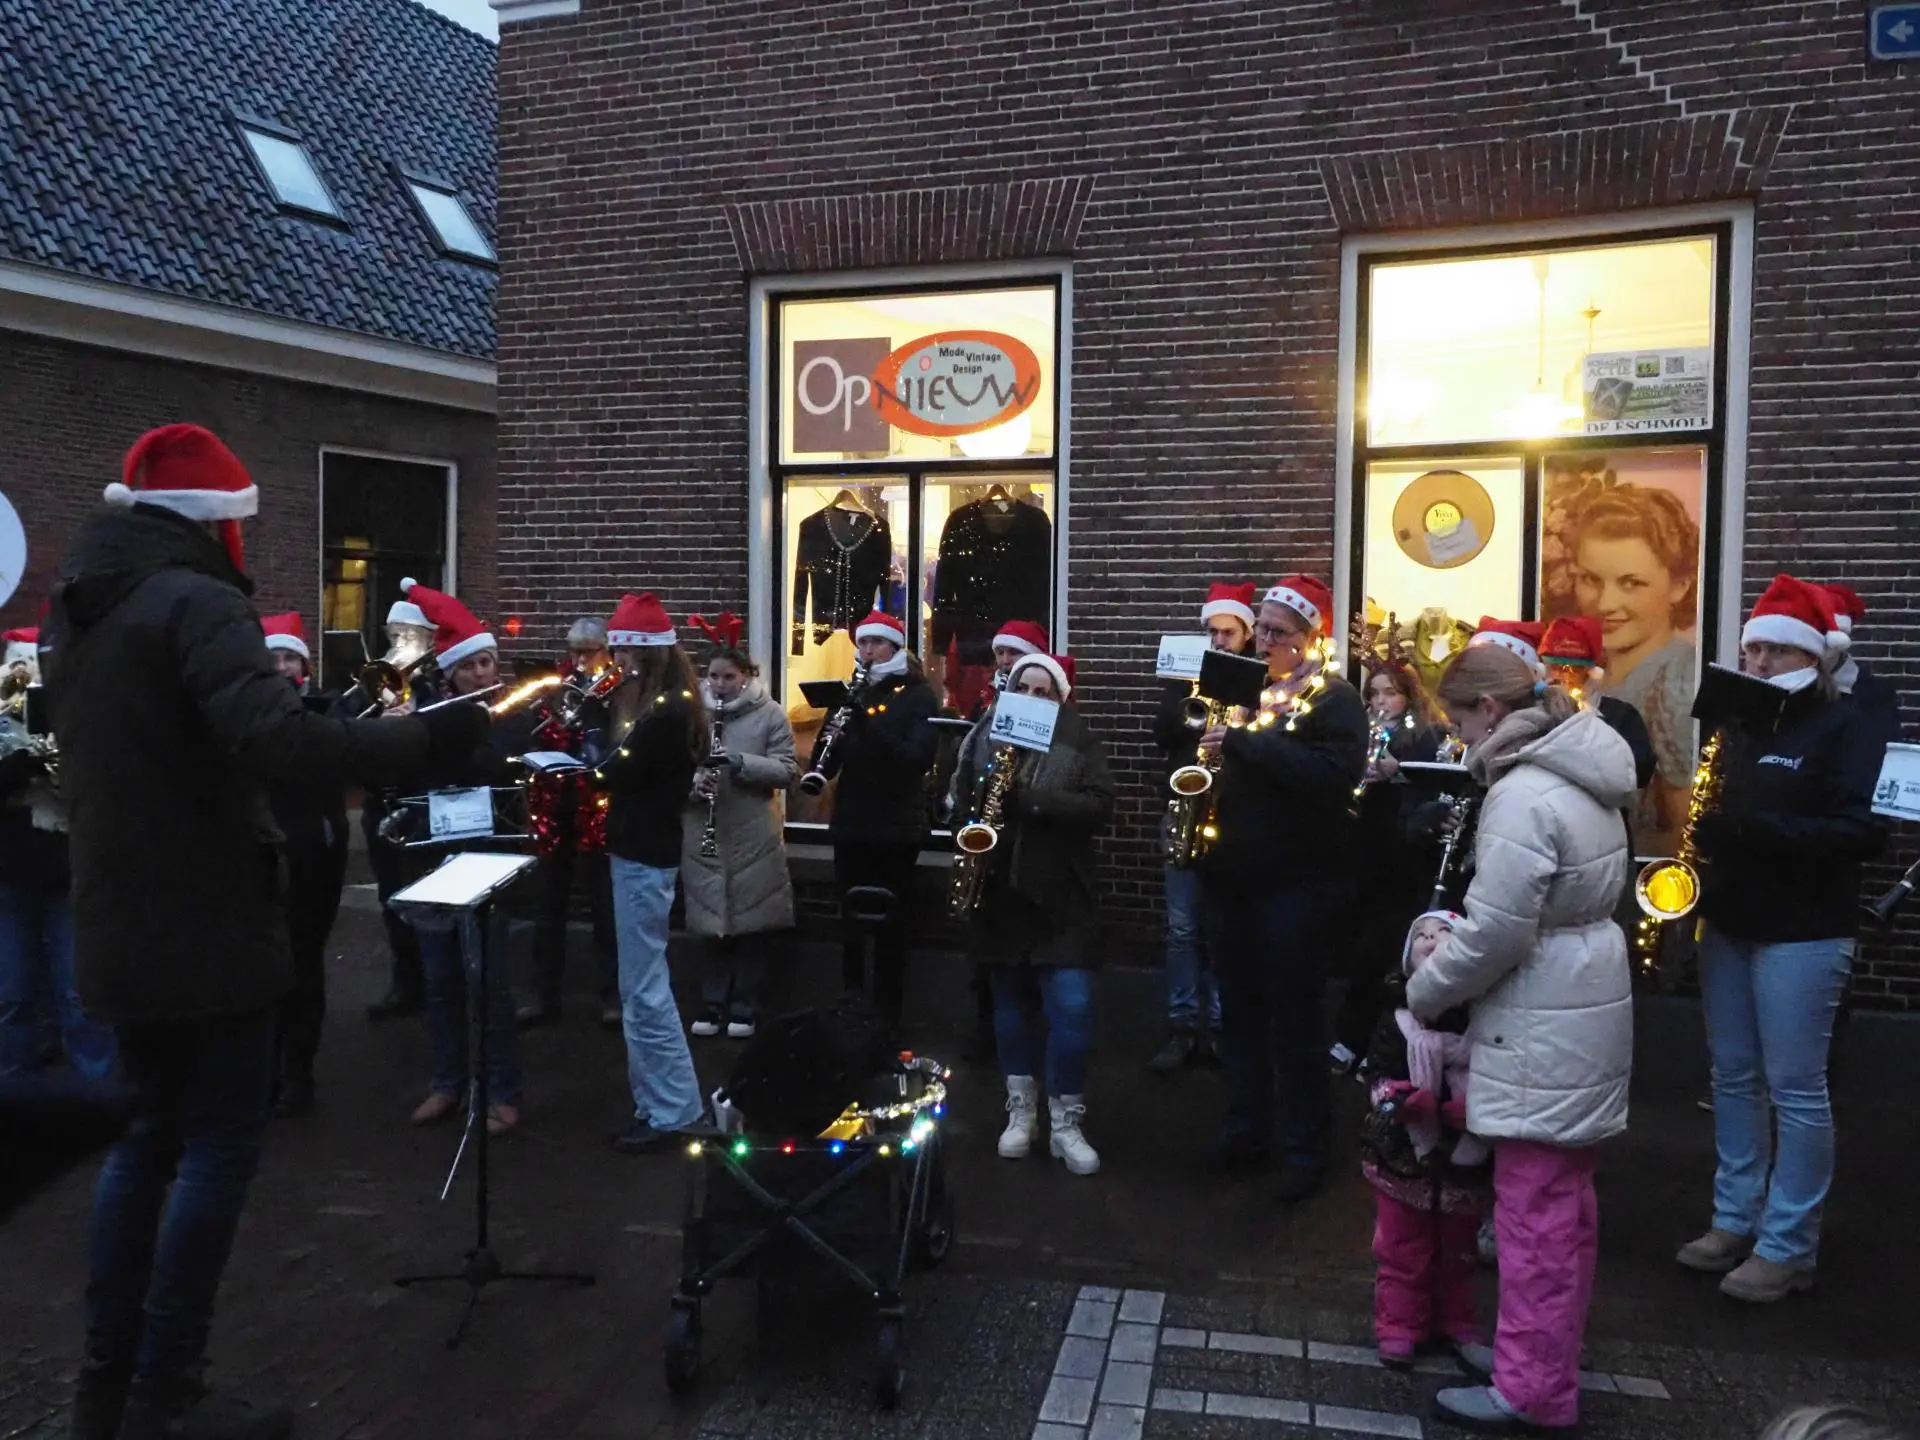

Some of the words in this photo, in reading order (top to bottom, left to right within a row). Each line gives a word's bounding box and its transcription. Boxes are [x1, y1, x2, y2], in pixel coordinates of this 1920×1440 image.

[939, 347, 965, 357] Mode
[966, 352, 1001, 362] Vintage
[953, 363, 982, 374] Design
[798, 356, 871, 431] Op
